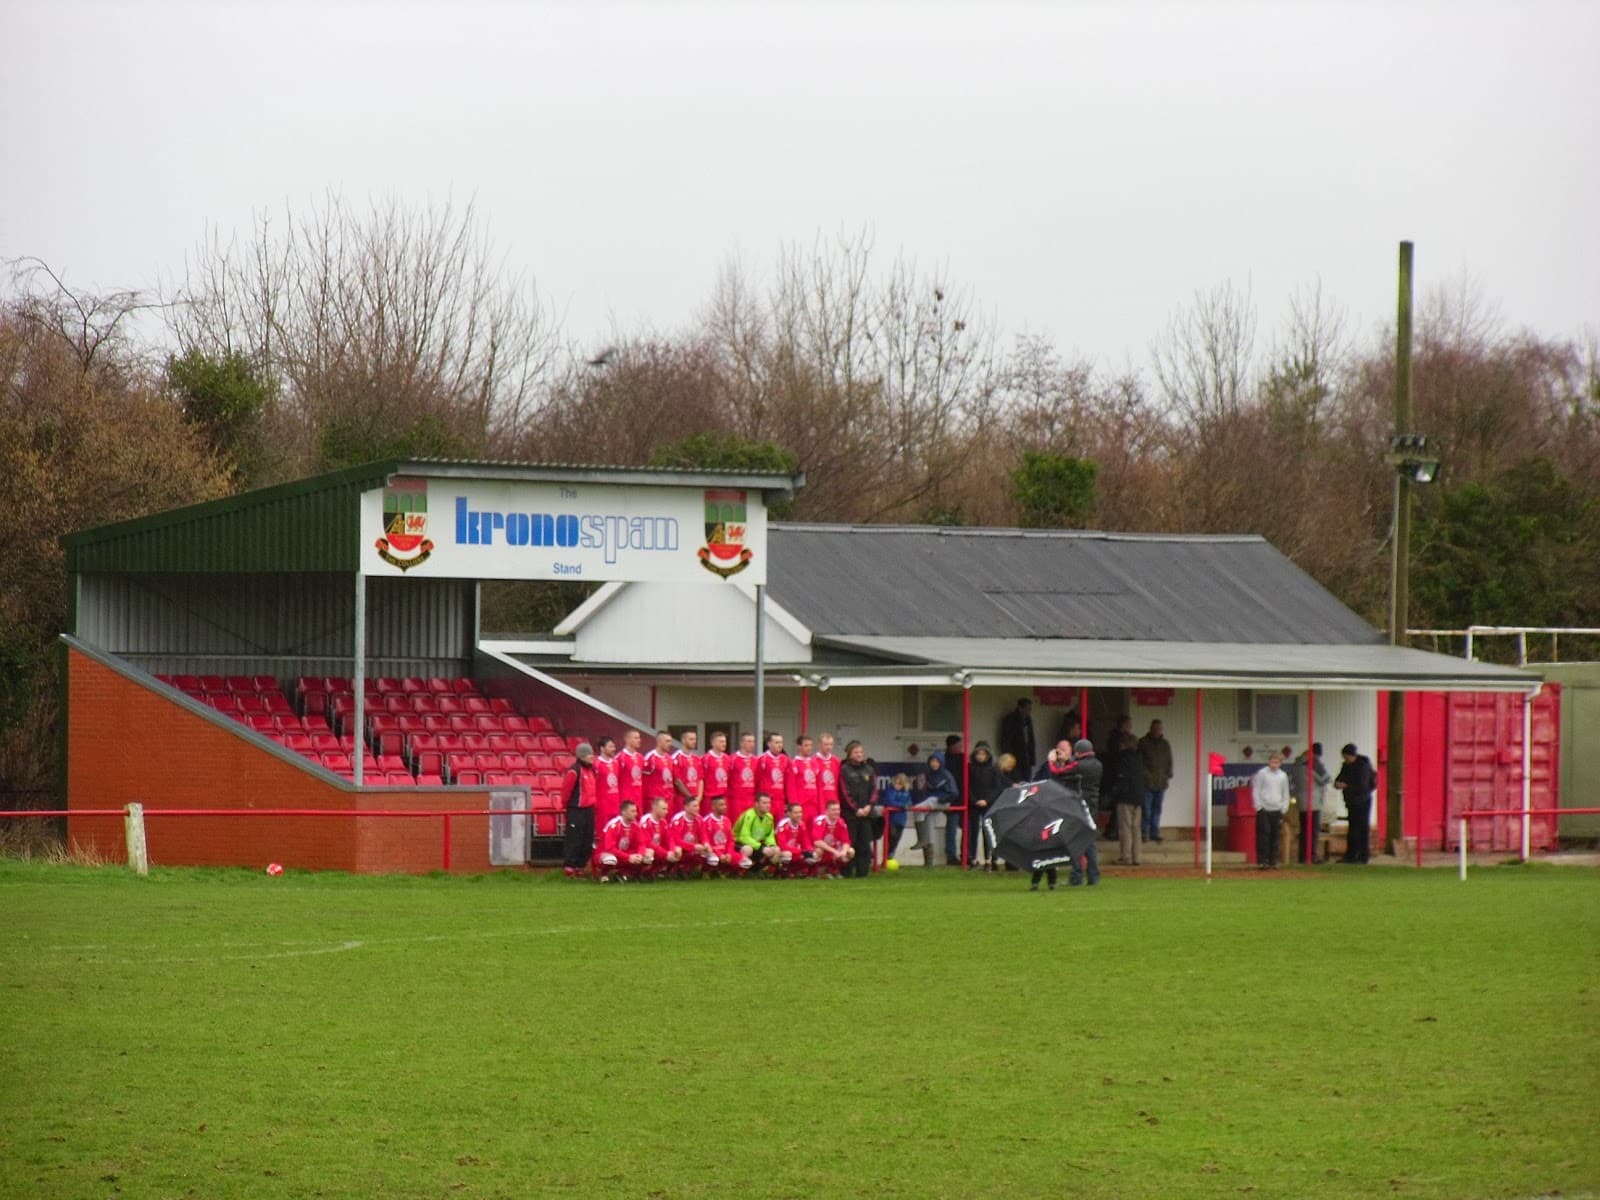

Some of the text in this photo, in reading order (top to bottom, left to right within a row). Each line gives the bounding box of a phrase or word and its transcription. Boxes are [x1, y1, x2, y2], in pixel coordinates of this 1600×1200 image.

[560, 487, 577, 499] The
[455, 496, 679, 564] kronospan
[553, 562, 582, 574] Stand
